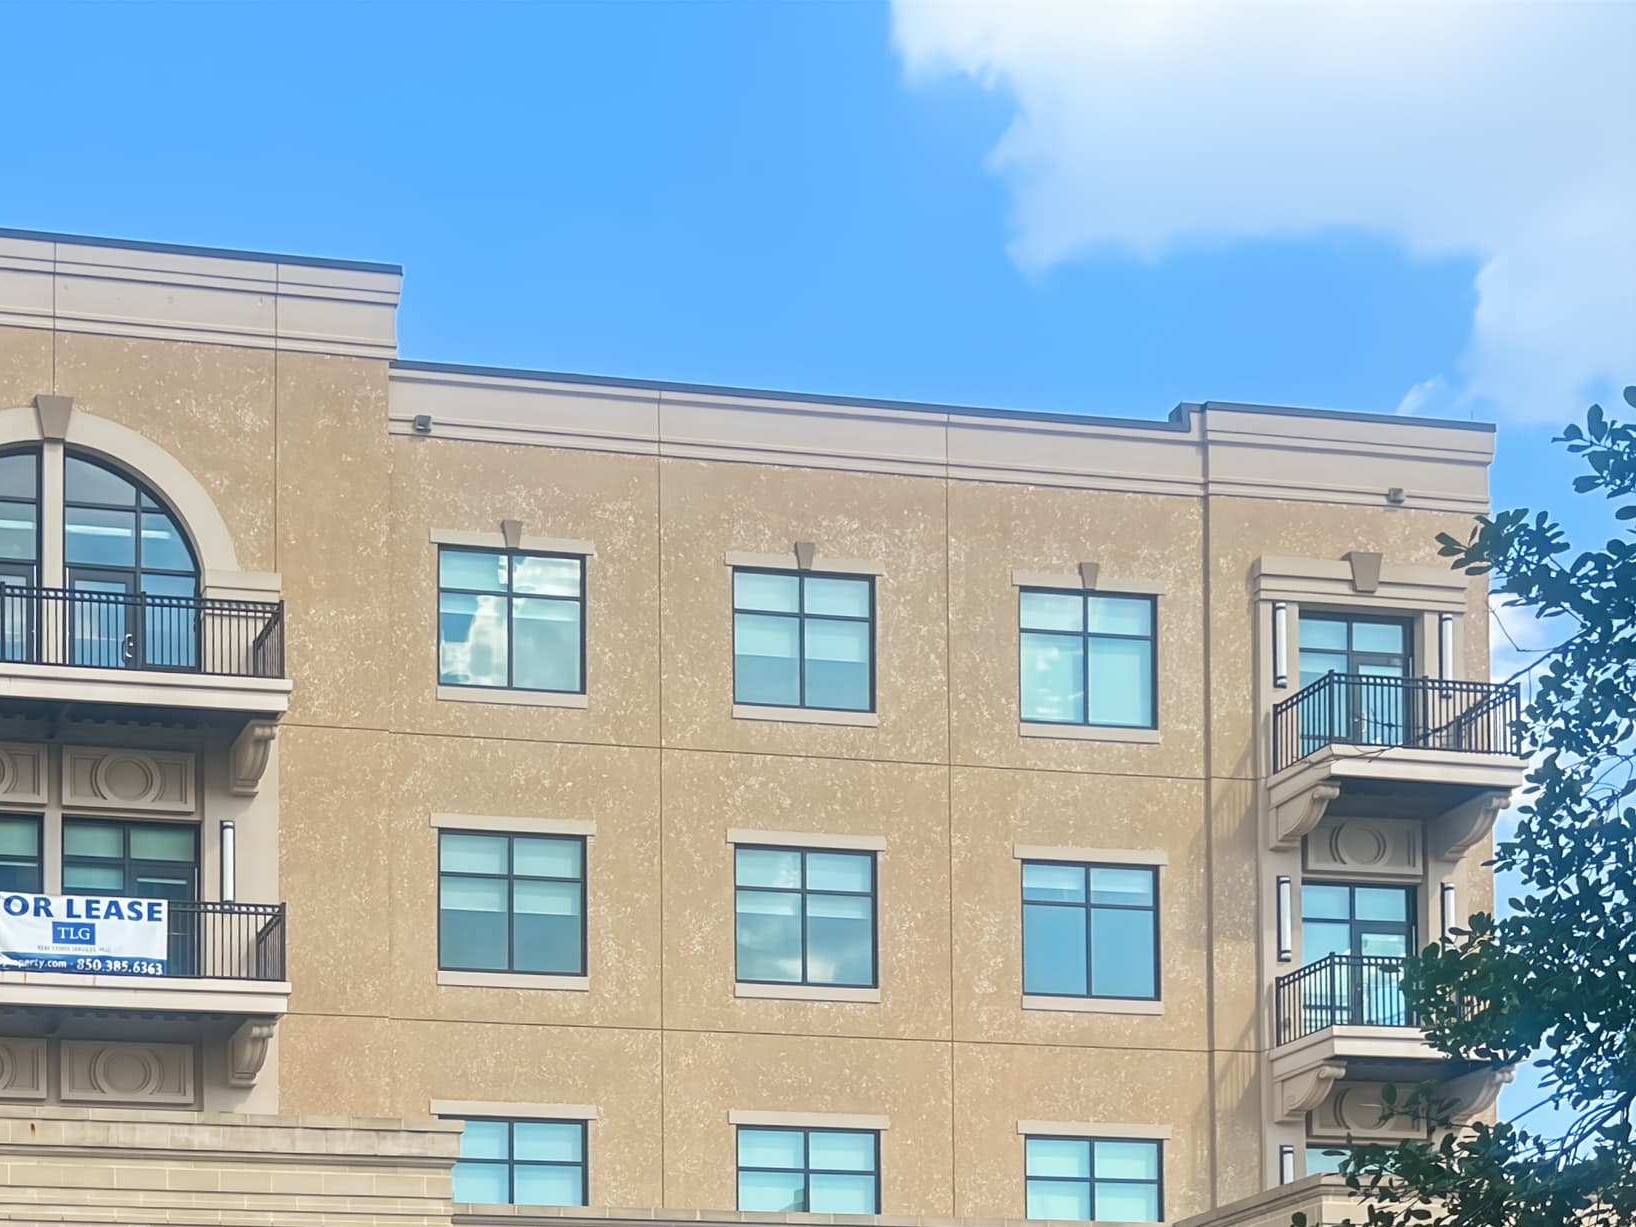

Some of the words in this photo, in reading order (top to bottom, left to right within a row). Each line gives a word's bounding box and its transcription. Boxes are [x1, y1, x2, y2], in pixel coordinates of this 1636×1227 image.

[66, 898, 163, 922] LEASE
[57, 926, 91, 941] TLG
[76, 957, 163, 976] 850.385.6363
